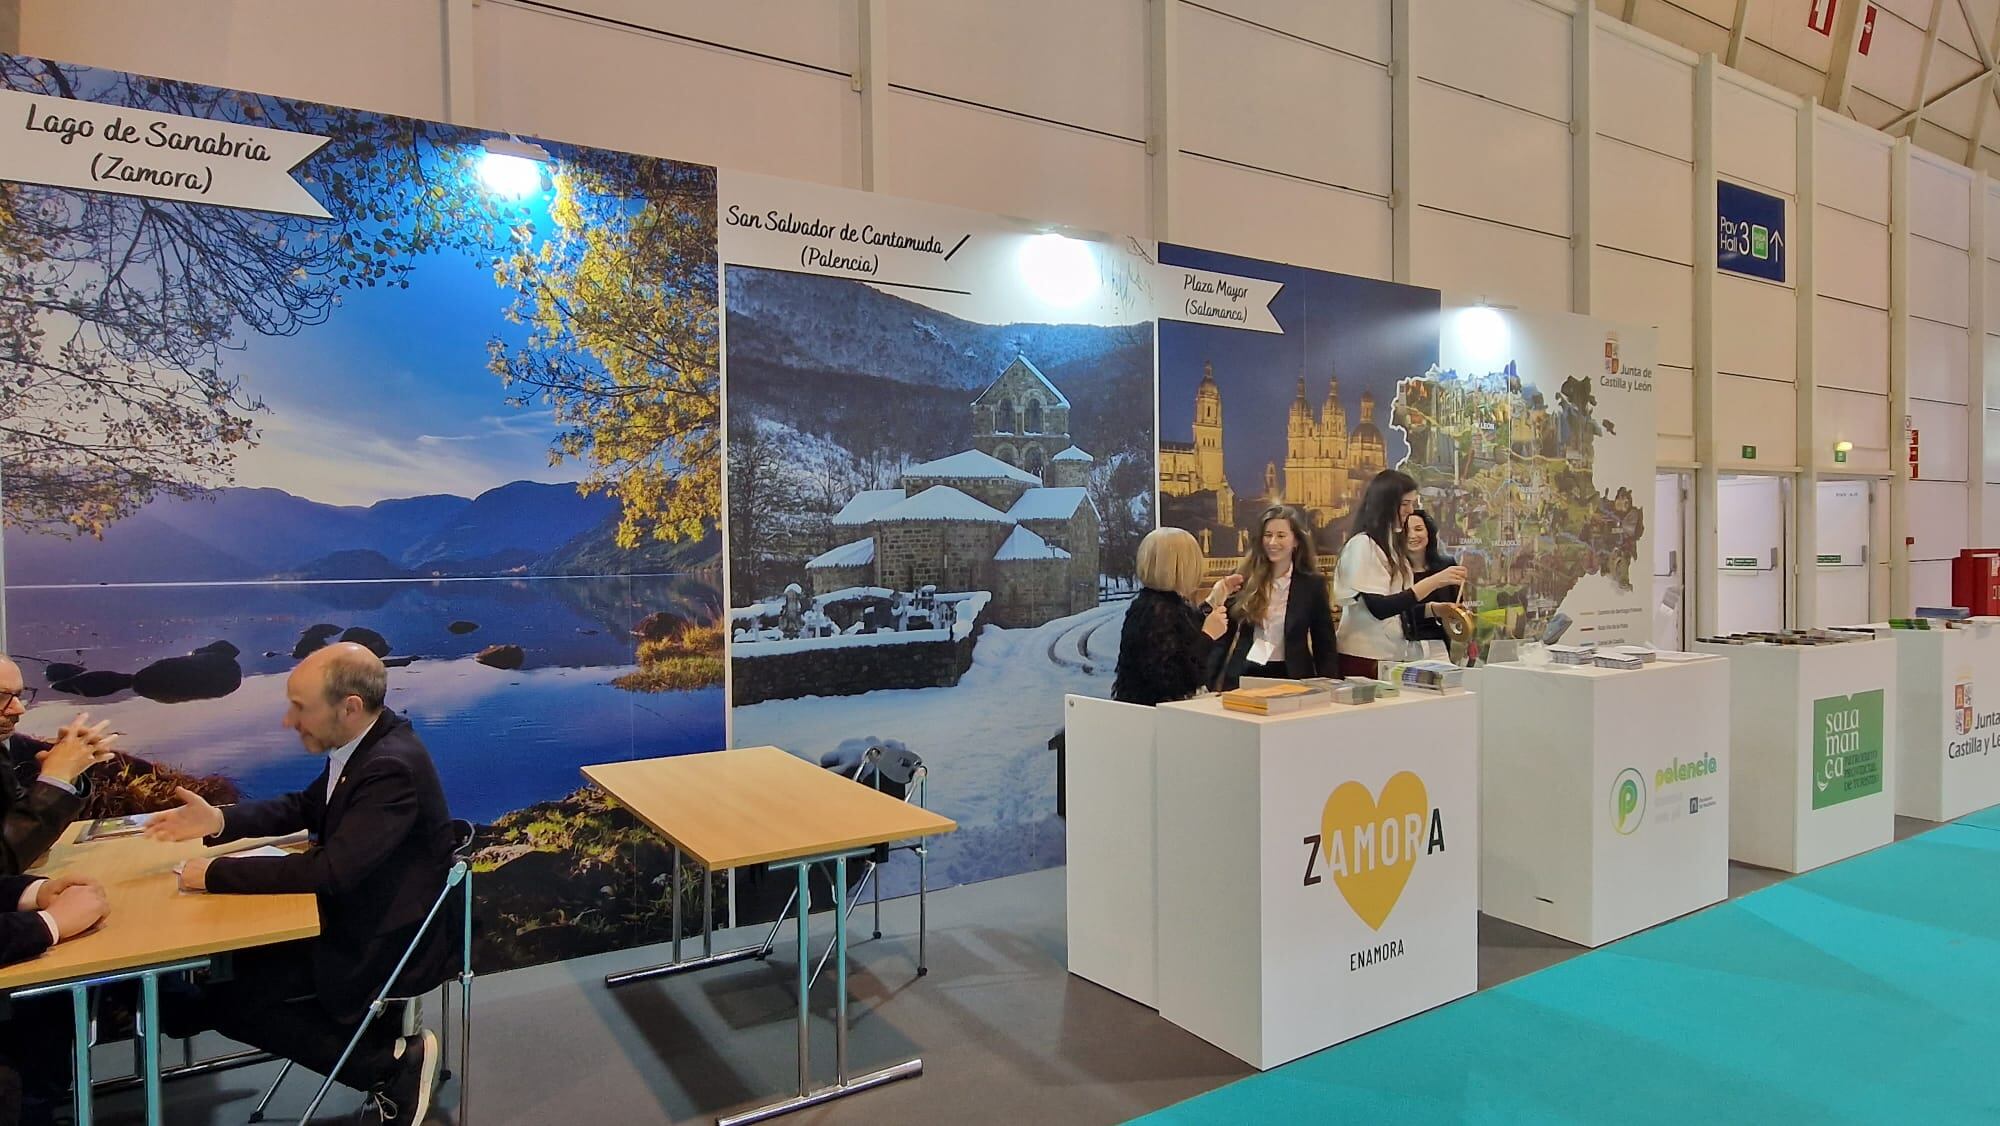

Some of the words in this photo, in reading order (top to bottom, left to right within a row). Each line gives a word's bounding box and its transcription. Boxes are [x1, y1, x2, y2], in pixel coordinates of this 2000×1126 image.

[25, 103, 94, 145] Lago
[104, 117, 140, 143] de
[145, 121, 271, 162] Sanabria
[90, 152, 213, 195] (Zamora)
[726, 204, 762, 229] San
[764, 210, 836, 239] Salvador
[839, 222, 859, 243] de
[861, 225, 944, 254] Cantamuda
[1720, 215, 1737, 235] Pav
[1738, 221, 1750, 255] 3
[1720, 233, 1737, 252] Hall
[800, 245, 879, 276] (Palencia)
[1184, 273, 1214, 294] Plaza
[1216, 279, 1248, 302] Mayor
[1185, 298, 1248, 323] (Salamanca)
[1600, 375, 1626, 389] Castilla
[1627, 381, 1633, 392] y
[1620, 363, 1641, 377] Junta
[1643, 367, 1652, 378] de
[1948, 736, 1982, 759] Castilla
[1983, 737, 1990, 756] y
[1303, 807, 1445, 887] ZAMORA
[1350, 938, 1405, 972] ENAMORA
